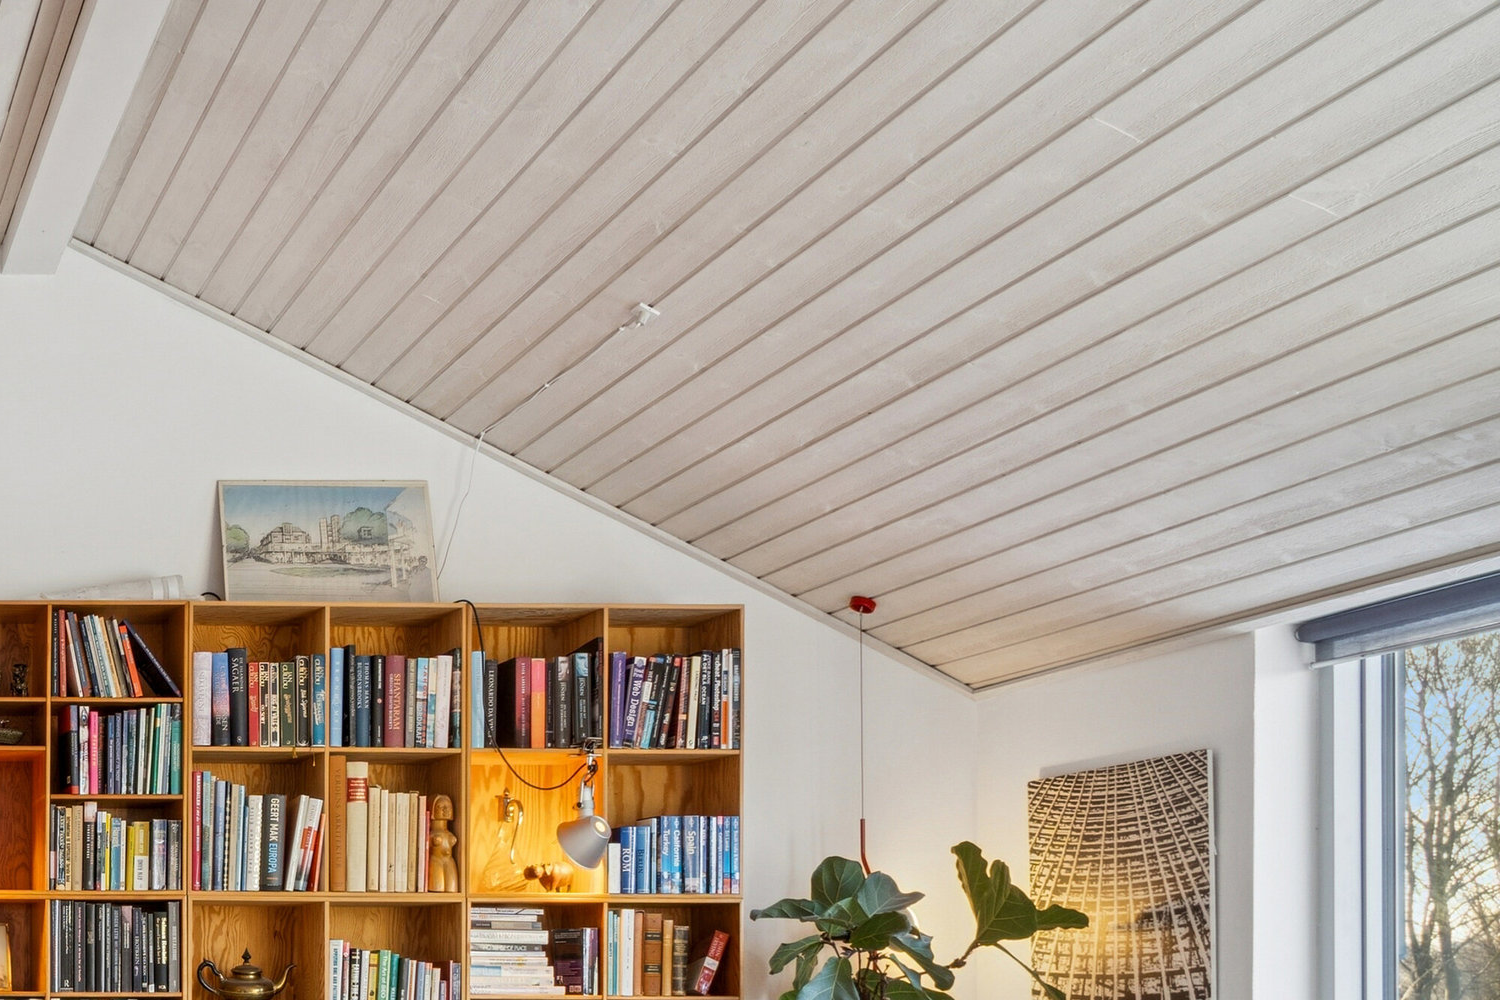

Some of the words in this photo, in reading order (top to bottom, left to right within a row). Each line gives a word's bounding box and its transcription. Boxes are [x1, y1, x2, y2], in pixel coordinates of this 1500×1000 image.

[231, 657, 239, 693] SAGAER
[393, 673, 401, 730] SHANTARAM
[632, 680, 642, 697] Web
[712, 679, 720, 711] Photoshop
[488, 707, 495, 718] DA
[627, 698, 640, 727] Design
[270, 798, 280, 822] GEERT
[269, 823, 279, 842] MAK
[662, 829, 670, 856] Turkey
[687, 830, 697, 855] Spain
[268, 843, 278, 873] EUROPA
[622, 848, 631, 872] ROM
[673, 830, 681, 867] California
[714, 941, 725, 957] JOHN
